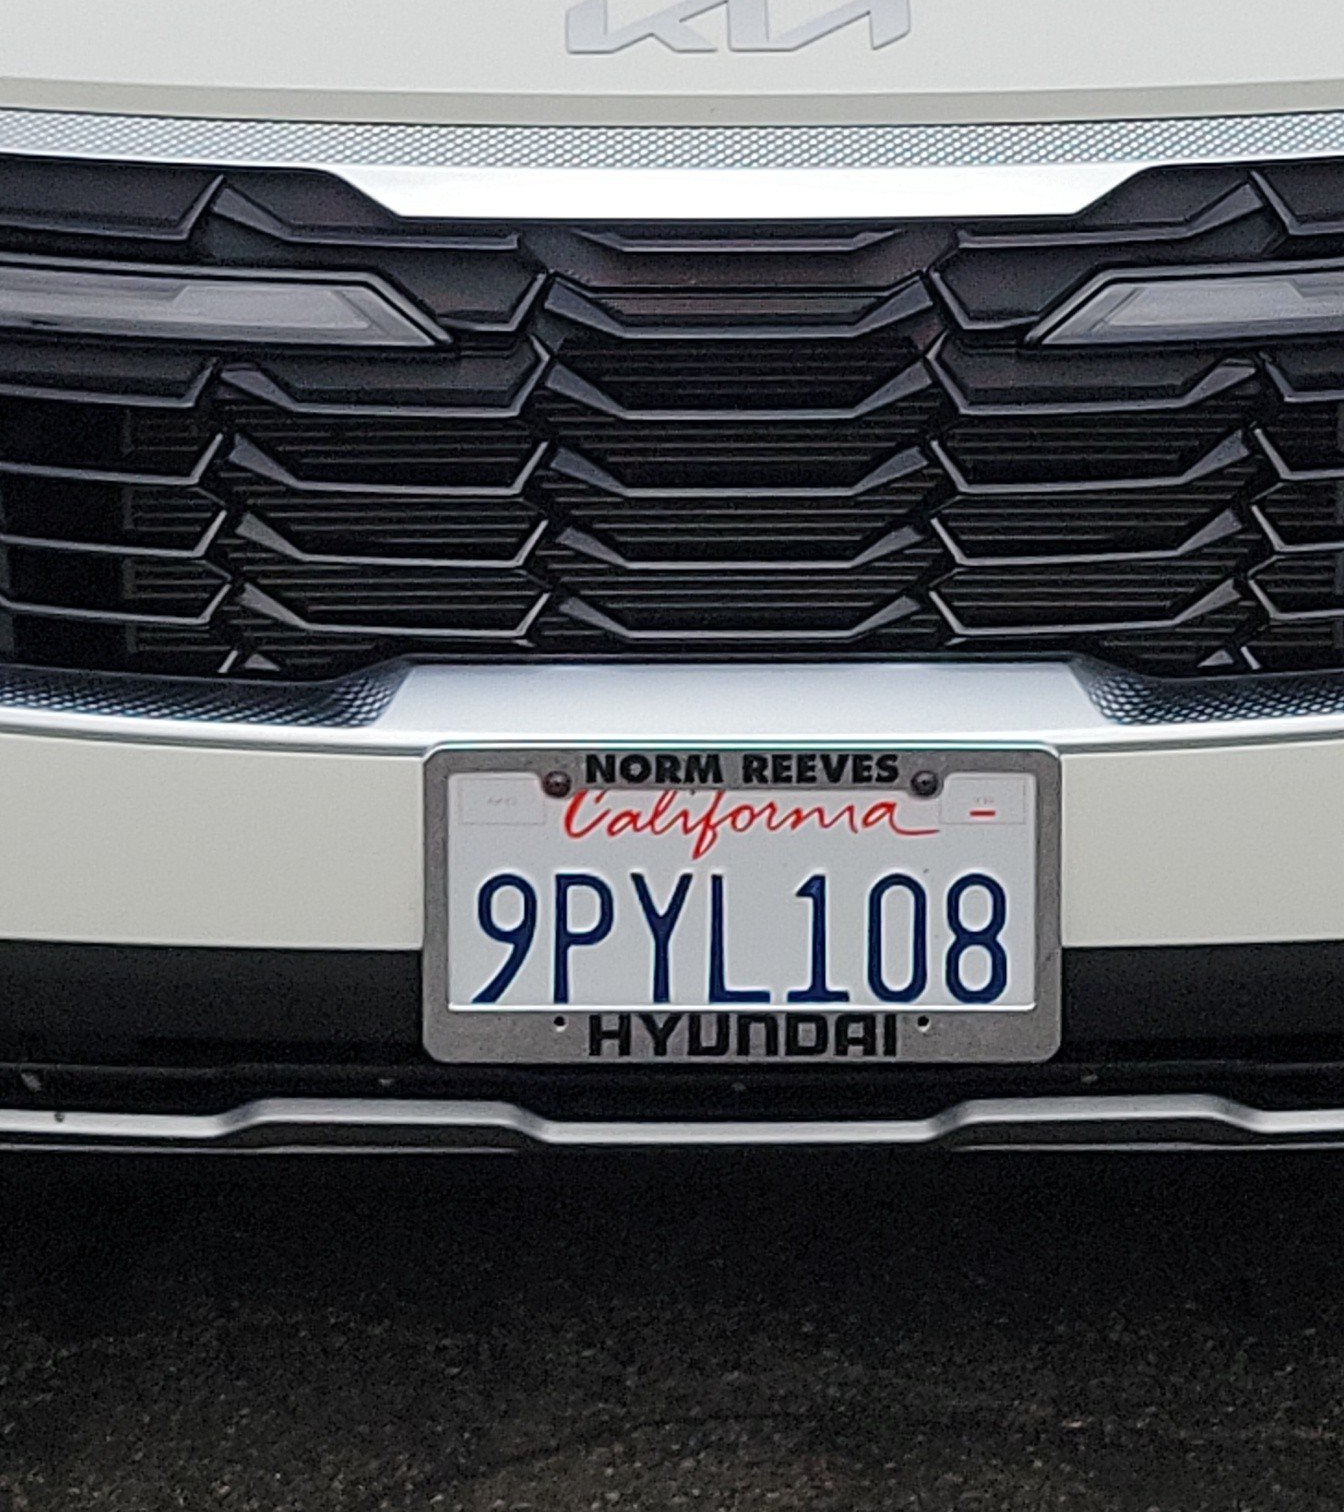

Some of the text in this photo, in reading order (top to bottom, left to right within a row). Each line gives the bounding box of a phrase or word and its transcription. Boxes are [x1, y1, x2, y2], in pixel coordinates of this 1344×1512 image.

[586, 752, 900, 785] NORM REEVES
[563, 789, 940, 859] California
[472, 873, 1008, 1004] 9PYL108
[587, 1012, 898, 1058] HYUNDAI
